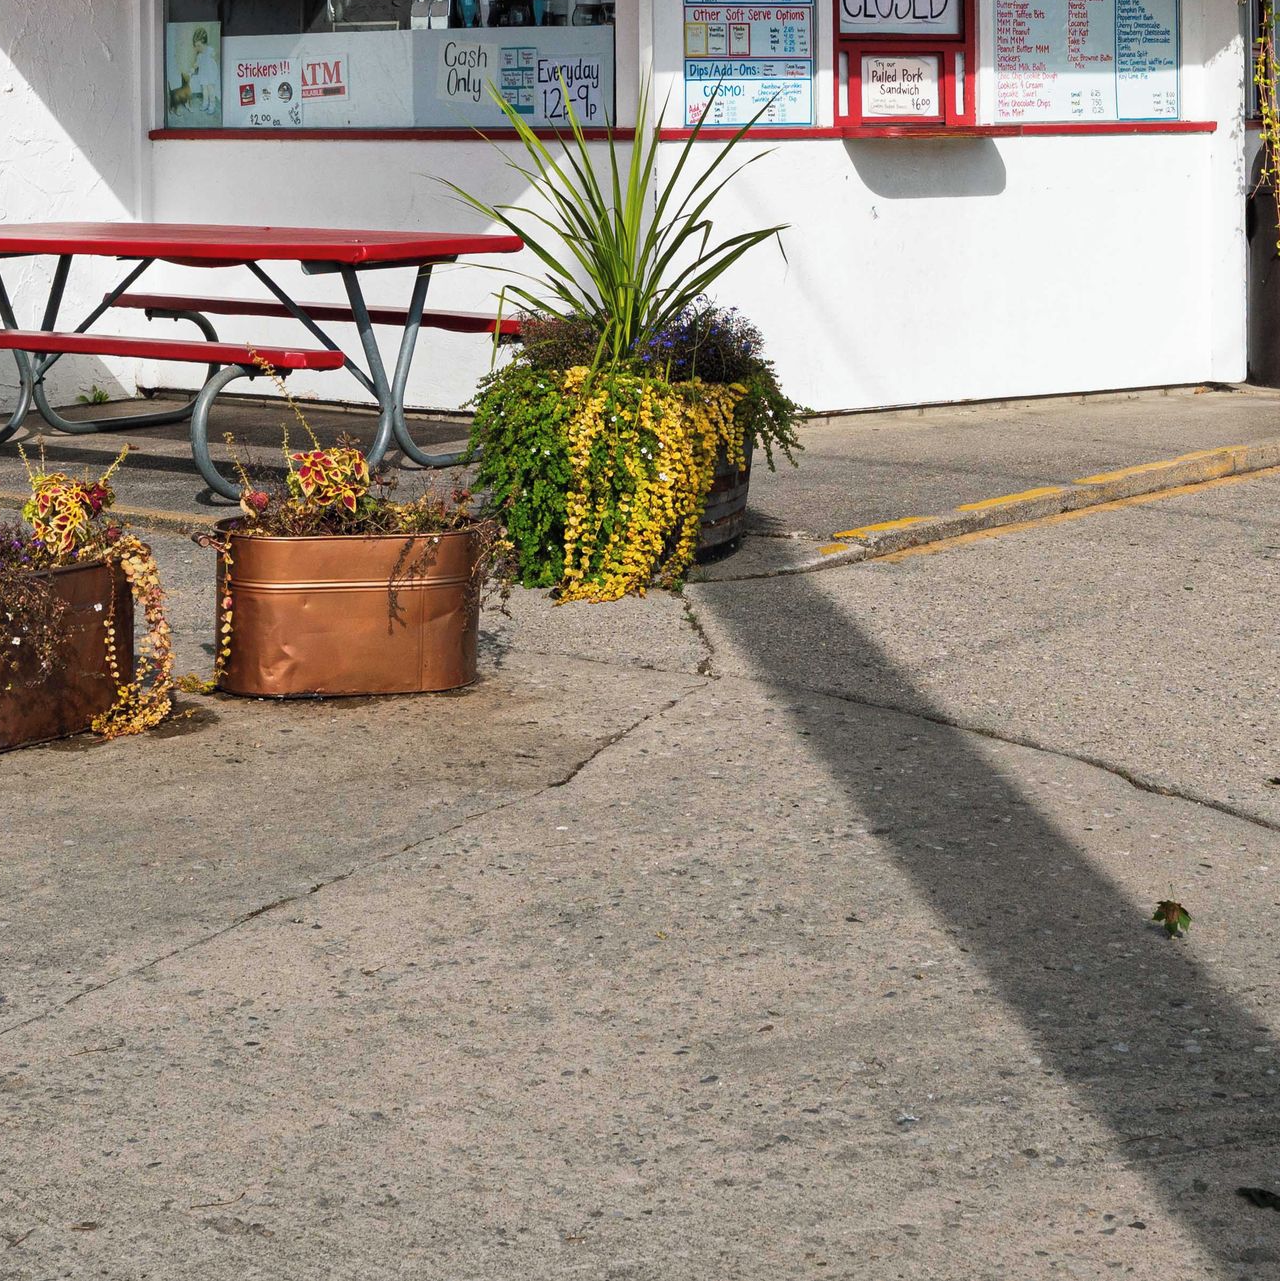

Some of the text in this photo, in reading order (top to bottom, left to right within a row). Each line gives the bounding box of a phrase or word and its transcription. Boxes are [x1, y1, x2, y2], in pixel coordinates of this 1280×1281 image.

[694, 9, 804, 26] Other Soft Serve Options
[997, 10, 1013, 18] Heath
[1068, 10, 1088, 19] Pretzel
[444, 42, 487, 67] Cash
[997, 54, 1020, 62] Snickers
[237, 62, 277, 78] Stickers
[689, 62, 760, 81] Dips/Add-Ons:
[874, 60, 884, 70] Try
[997, 62, 1016, 71] Malted
[537, 58, 600, 88] Everyday
[872, 68, 923, 83] Pulled Pork
[447, 68, 482, 103] Only
[880, 83, 920, 96] Sandwich
